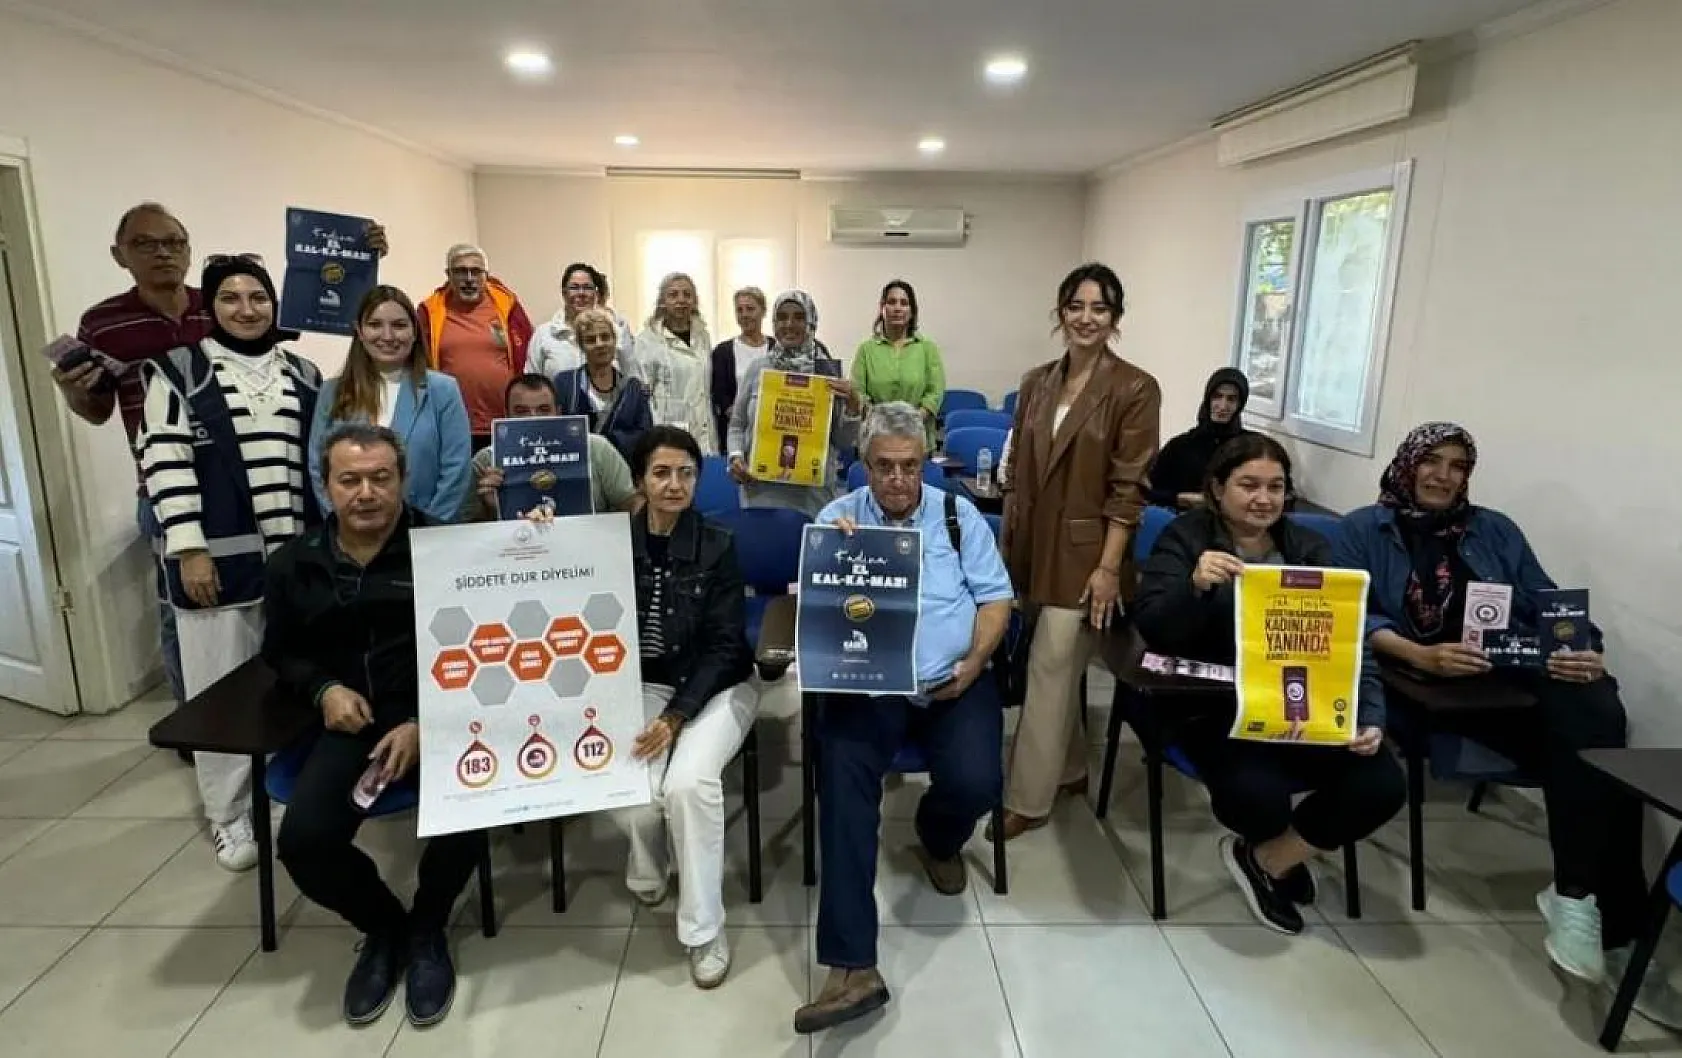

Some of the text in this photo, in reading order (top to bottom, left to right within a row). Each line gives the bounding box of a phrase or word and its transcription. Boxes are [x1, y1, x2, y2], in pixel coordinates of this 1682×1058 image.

[455, 566, 595, 590] ŞİDDETE DUR DİYELİM!
[1265, 616, 1334, 634] KADINLARIN
[1266, 633, 1331, 652] YANINDA
[582, 740, 606, 757] 112
[464, 756, 491, 774] 183
